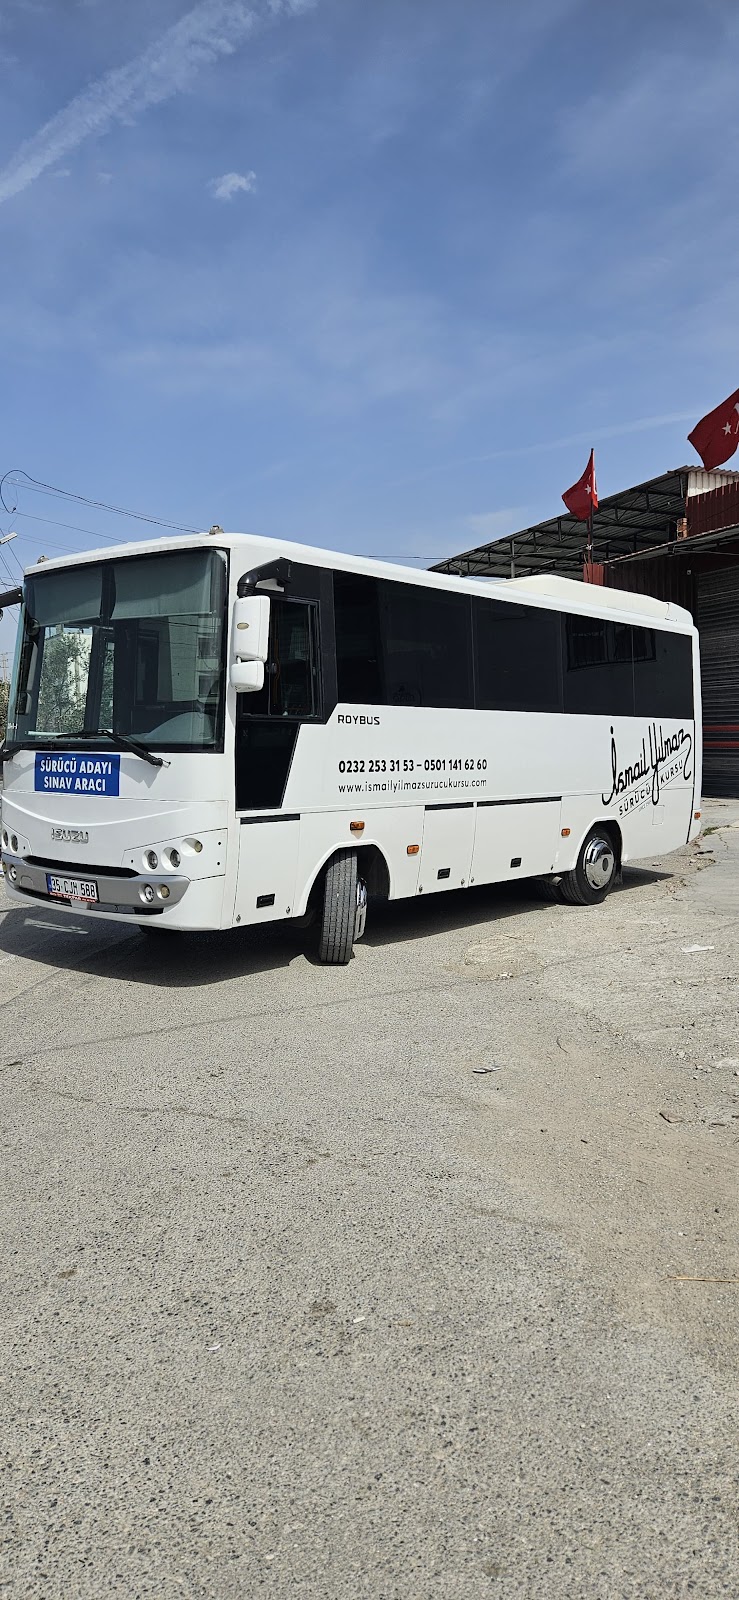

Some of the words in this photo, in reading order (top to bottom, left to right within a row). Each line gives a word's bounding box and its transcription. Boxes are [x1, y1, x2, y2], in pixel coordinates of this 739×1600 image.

[337, 714, 380, 726] ROYBUS
[40, 756, 77, 773] SÜRÜCÜ
[79, 761, 112, 775] ADAYI
[338, 760, 366, 774] 0232
[368, 759, 387, 773] 253
[389, 759, 400, 772] 31
[403, 759, 414, 772] 53
[424, 759, 446, 771] 0501
[448, 759, 462, 771] 141
[464, 758, 474, 771] 62
[476, 758, 488, 771] 60
[43, 775, 73, 790] SINAV
[74, 778, 106, 792] ARACI
[338, 778, 488, 793] www.ismailyilmazsurucukursu.com
[618, 783, 651, 816] SÜRÜCÜ
[660, 759, 684, 785] KURSU
[51, 827, 89, 844] ISUZU
[51, 878, 61, 892] 35
[80, 883, 96, 898] 588
